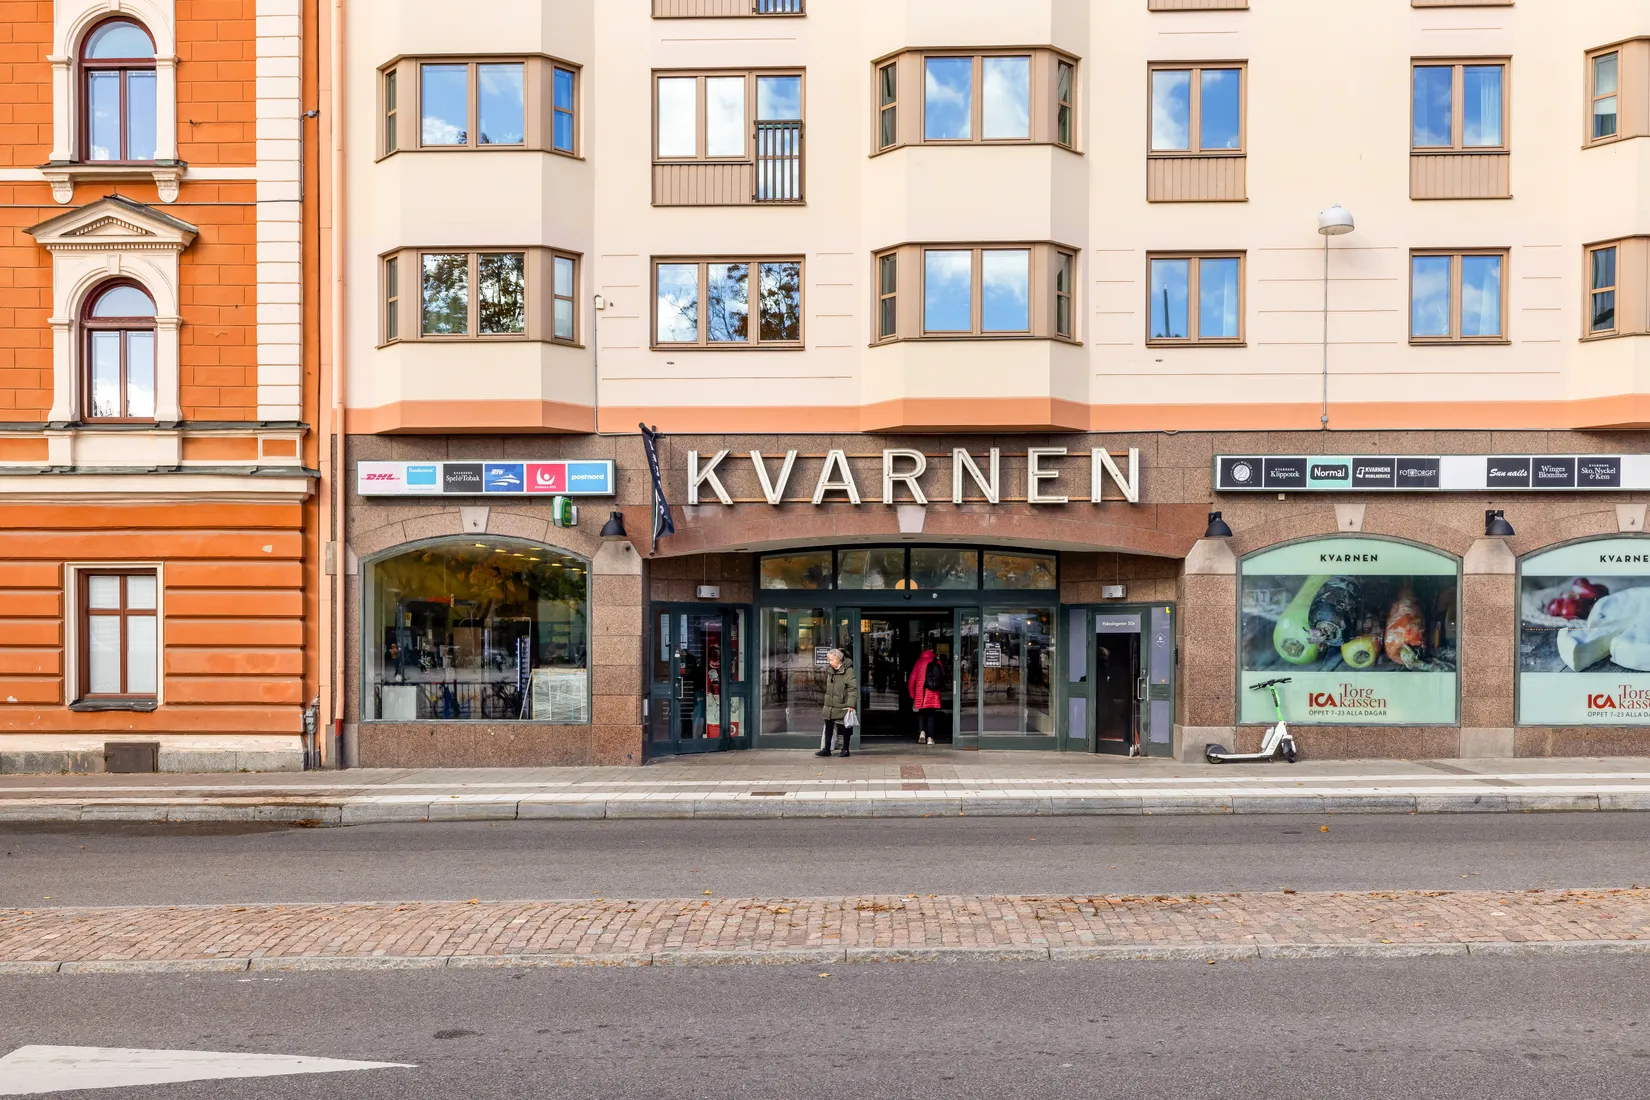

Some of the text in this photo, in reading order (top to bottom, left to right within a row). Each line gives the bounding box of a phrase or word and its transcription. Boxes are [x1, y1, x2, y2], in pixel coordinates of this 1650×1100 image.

[1270, 470, 1301, 479] Klippotek
[1314, 466, 1345, 477] Normal
[1489, 468, 1529, 477] Sun nails
[1541, 465, 1566, 474] Winges
[1594, 467, 1616, 475] Nyckel
[365, 473, 395, 481] DHL
[571, 473, 605, 484] postnord
[687, 447, 1139, 505] KVARNEN
[1320, 554, 1378, 562] KVARNEN
[1599, 554, 1650, 563] KVARNE
[1339, 683, 1374, 700] Torg
[1309, 692, 1338, 708] ICA
[1339, 692, 1387, 708] kassen
[1587, 693, 1617, 709] ICA
[1618, 694, 1650, 709] kass
